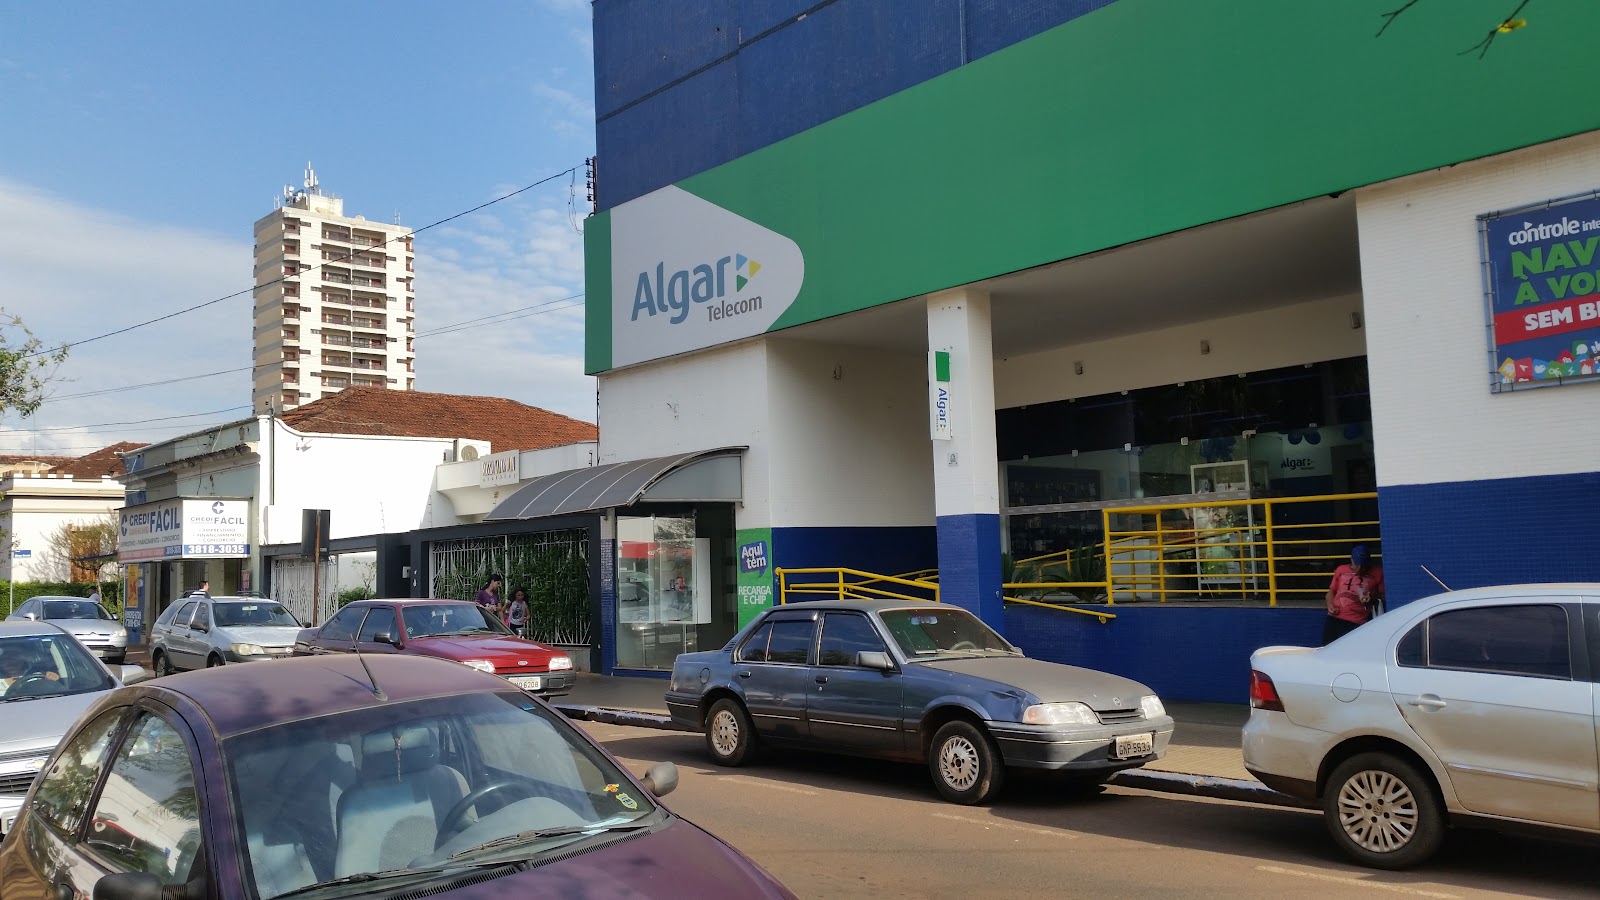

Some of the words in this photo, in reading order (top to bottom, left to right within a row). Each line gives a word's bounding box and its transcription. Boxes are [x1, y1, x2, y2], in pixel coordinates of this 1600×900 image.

[1508, 216, 1580, 246] controle
[631, 255, 731, 325] Algar
[1546, 269, 1600, 298] VO
[706, 295, 763, 322] Telecom
[1524, 306, 1574, 331] SEM
[1578, 300, 1600, 321] B
[936, 387, 948, 423] Algar
[1281, 457, 1307, 470] Algar
[188, 544, 245, 554] 3818-3035
[741, 542, 764, 559] Aqui
[738, 585, 772, 596] RECARGA
[743, 595, 749, 605] E
[749, 594, 767, 605] CHIP
